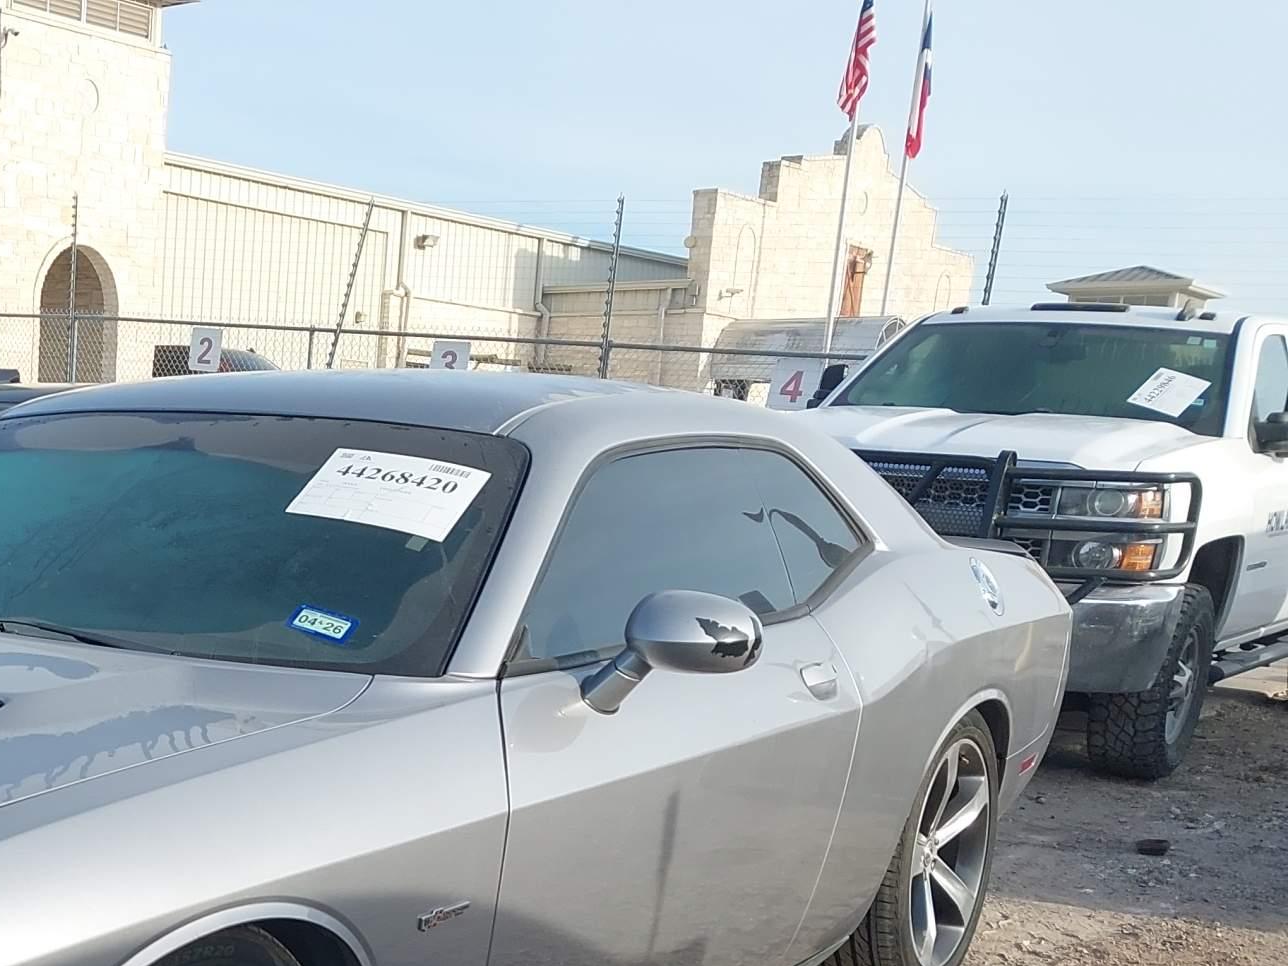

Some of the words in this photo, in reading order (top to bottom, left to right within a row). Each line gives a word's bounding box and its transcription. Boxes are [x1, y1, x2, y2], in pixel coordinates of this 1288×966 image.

[197, 337, 213, 365] 2
[779, 370, 804, 403] 4
[336, 463, 459, 495] 44268420
[323, 622, 344, 635] 26
